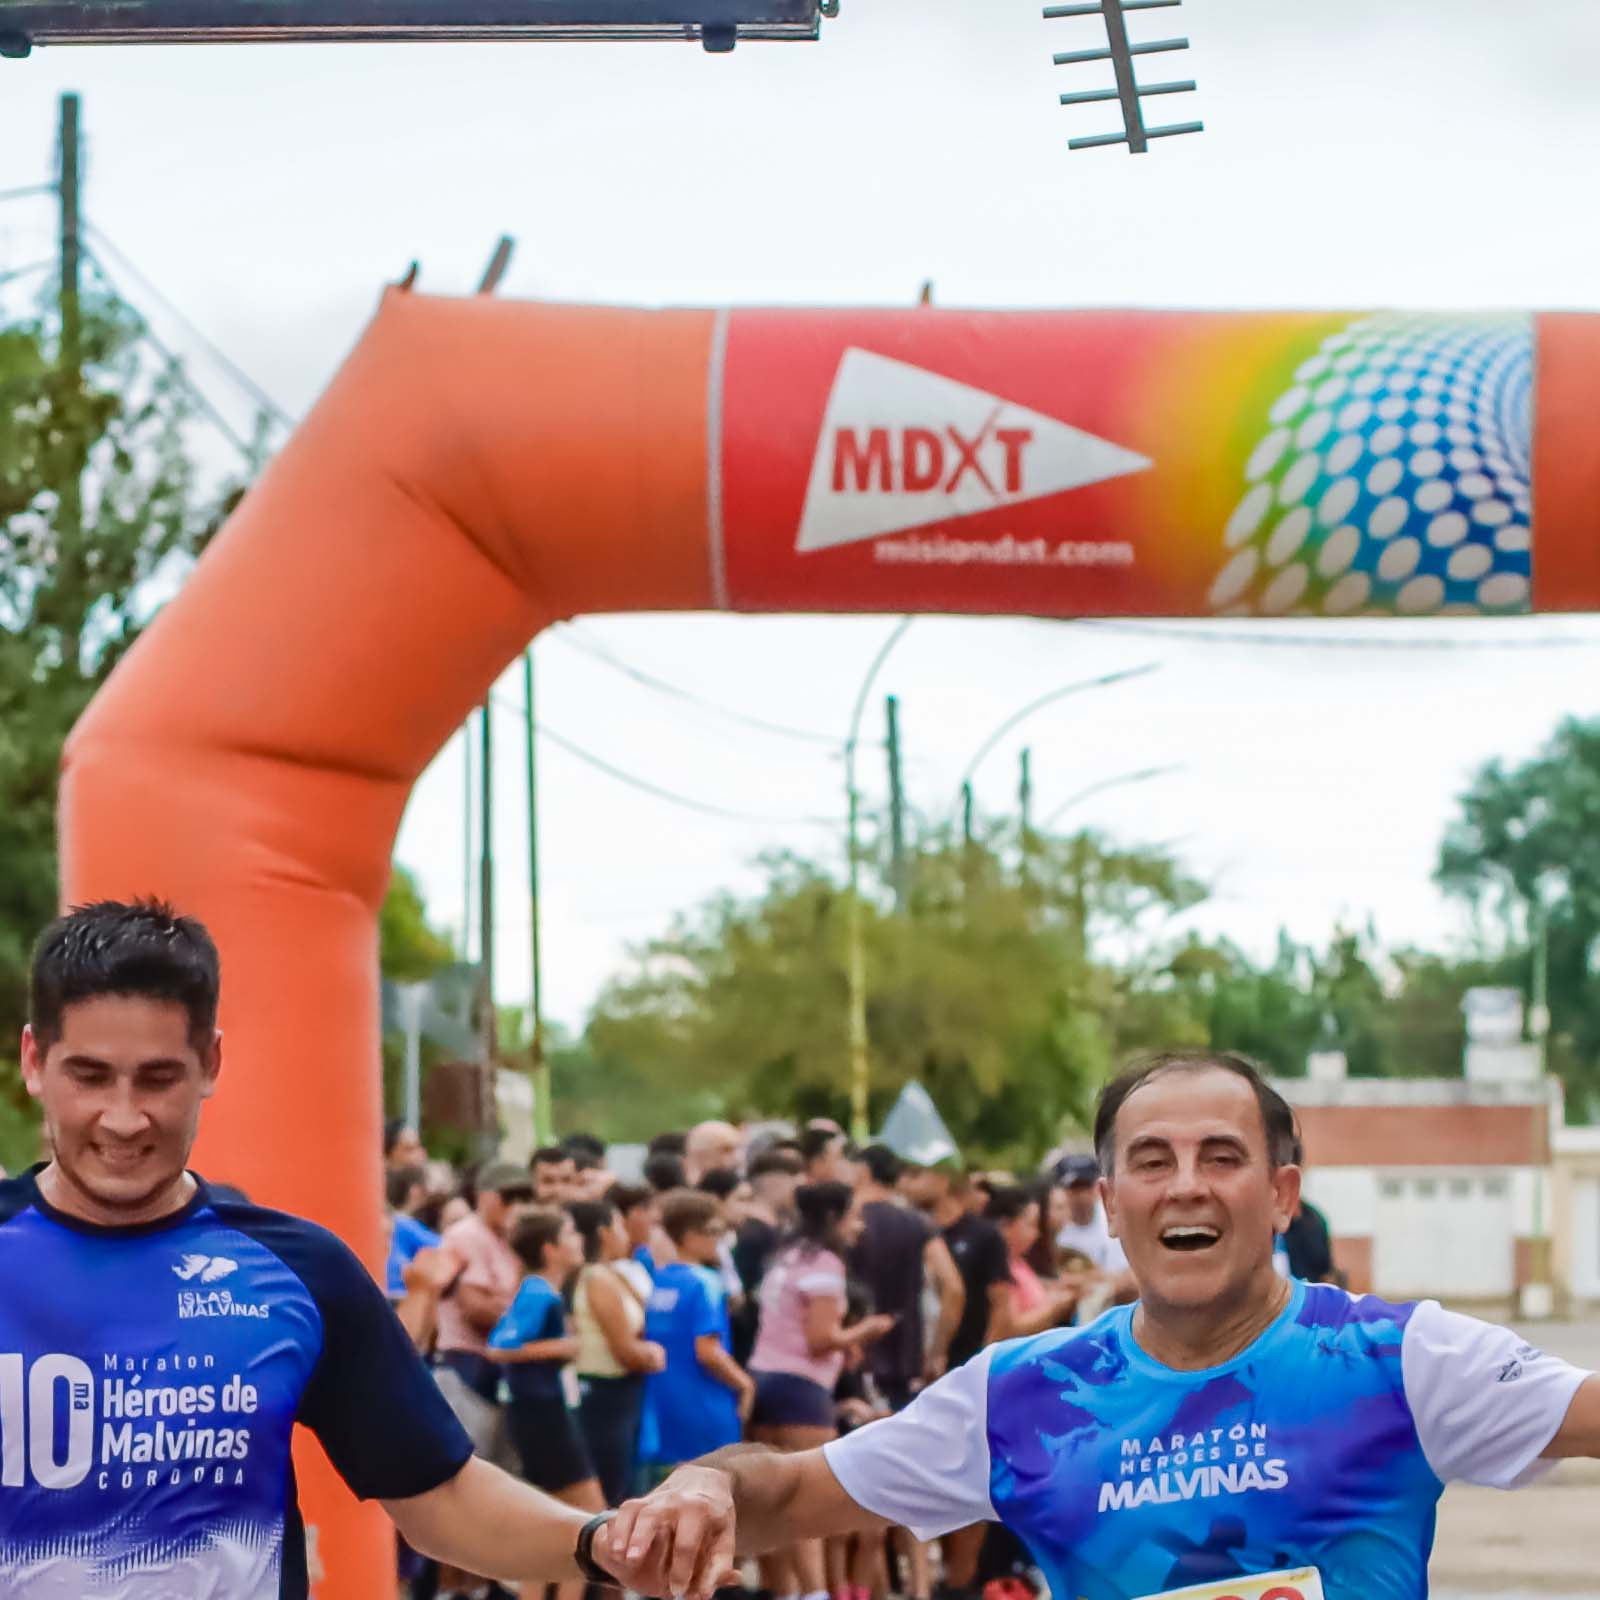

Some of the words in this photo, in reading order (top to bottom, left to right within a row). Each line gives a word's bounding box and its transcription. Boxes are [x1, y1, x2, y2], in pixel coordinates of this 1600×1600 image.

[831, 402, 1033, 498] MDXT
[177, 1290, 232, 1305] ISLAS
[178, 1303, 270, 1319] MALVINAS
[103, 1353, 215, 1372] Maraton
[102, 1373, 215, 1418] Héroes
[221, 1374, 258, 1414] de
[101, 1419, 250, 1464] Malvinas
[1120, 1422, 1267, 1456] MARATÓN
[1235, 1443, 1266, 1457] DE
[98, 1466, 243, 1490] CÓRDOBA
[1098, 1459, 1289, 1513] MALVINAS
